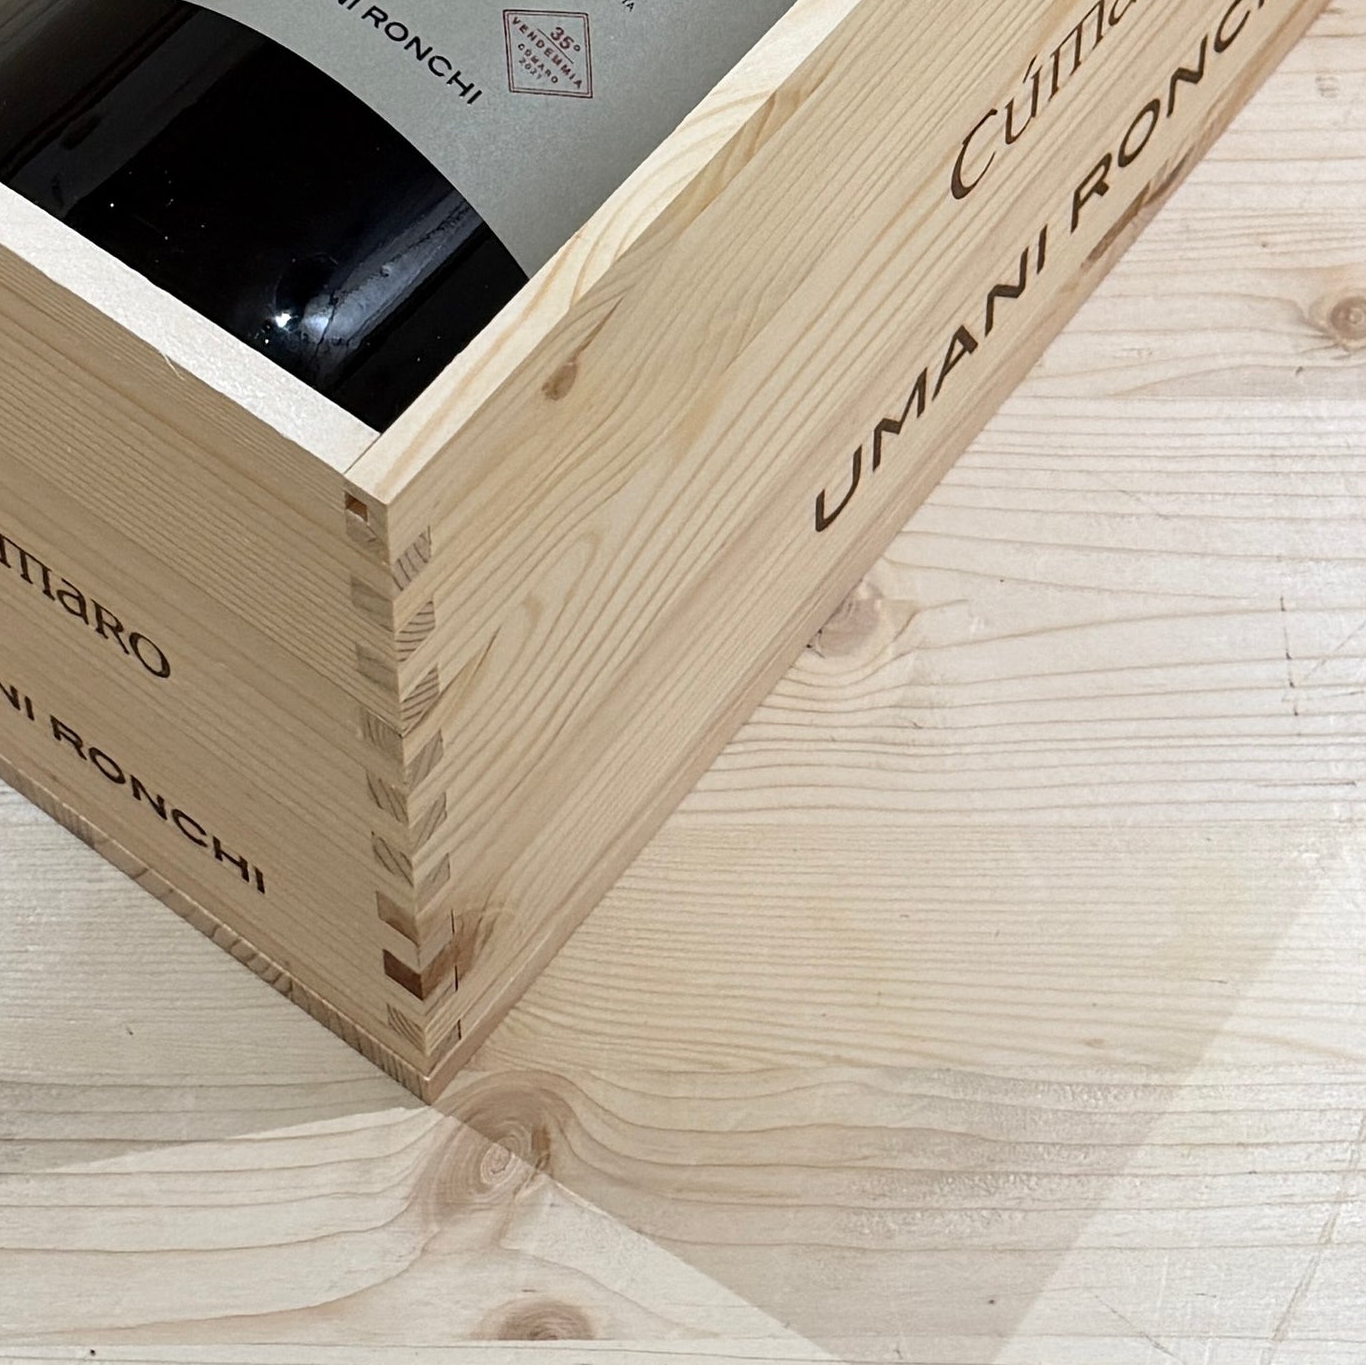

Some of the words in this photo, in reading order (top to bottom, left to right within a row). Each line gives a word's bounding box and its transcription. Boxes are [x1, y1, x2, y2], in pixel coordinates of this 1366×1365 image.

[361, 4, 484, 106] RONCHI
[511, 15, 584, 90] VENDEMMIA
[813, 224, 1050, 533] UMANI
[49, 714, 267, 895] RONCHI
